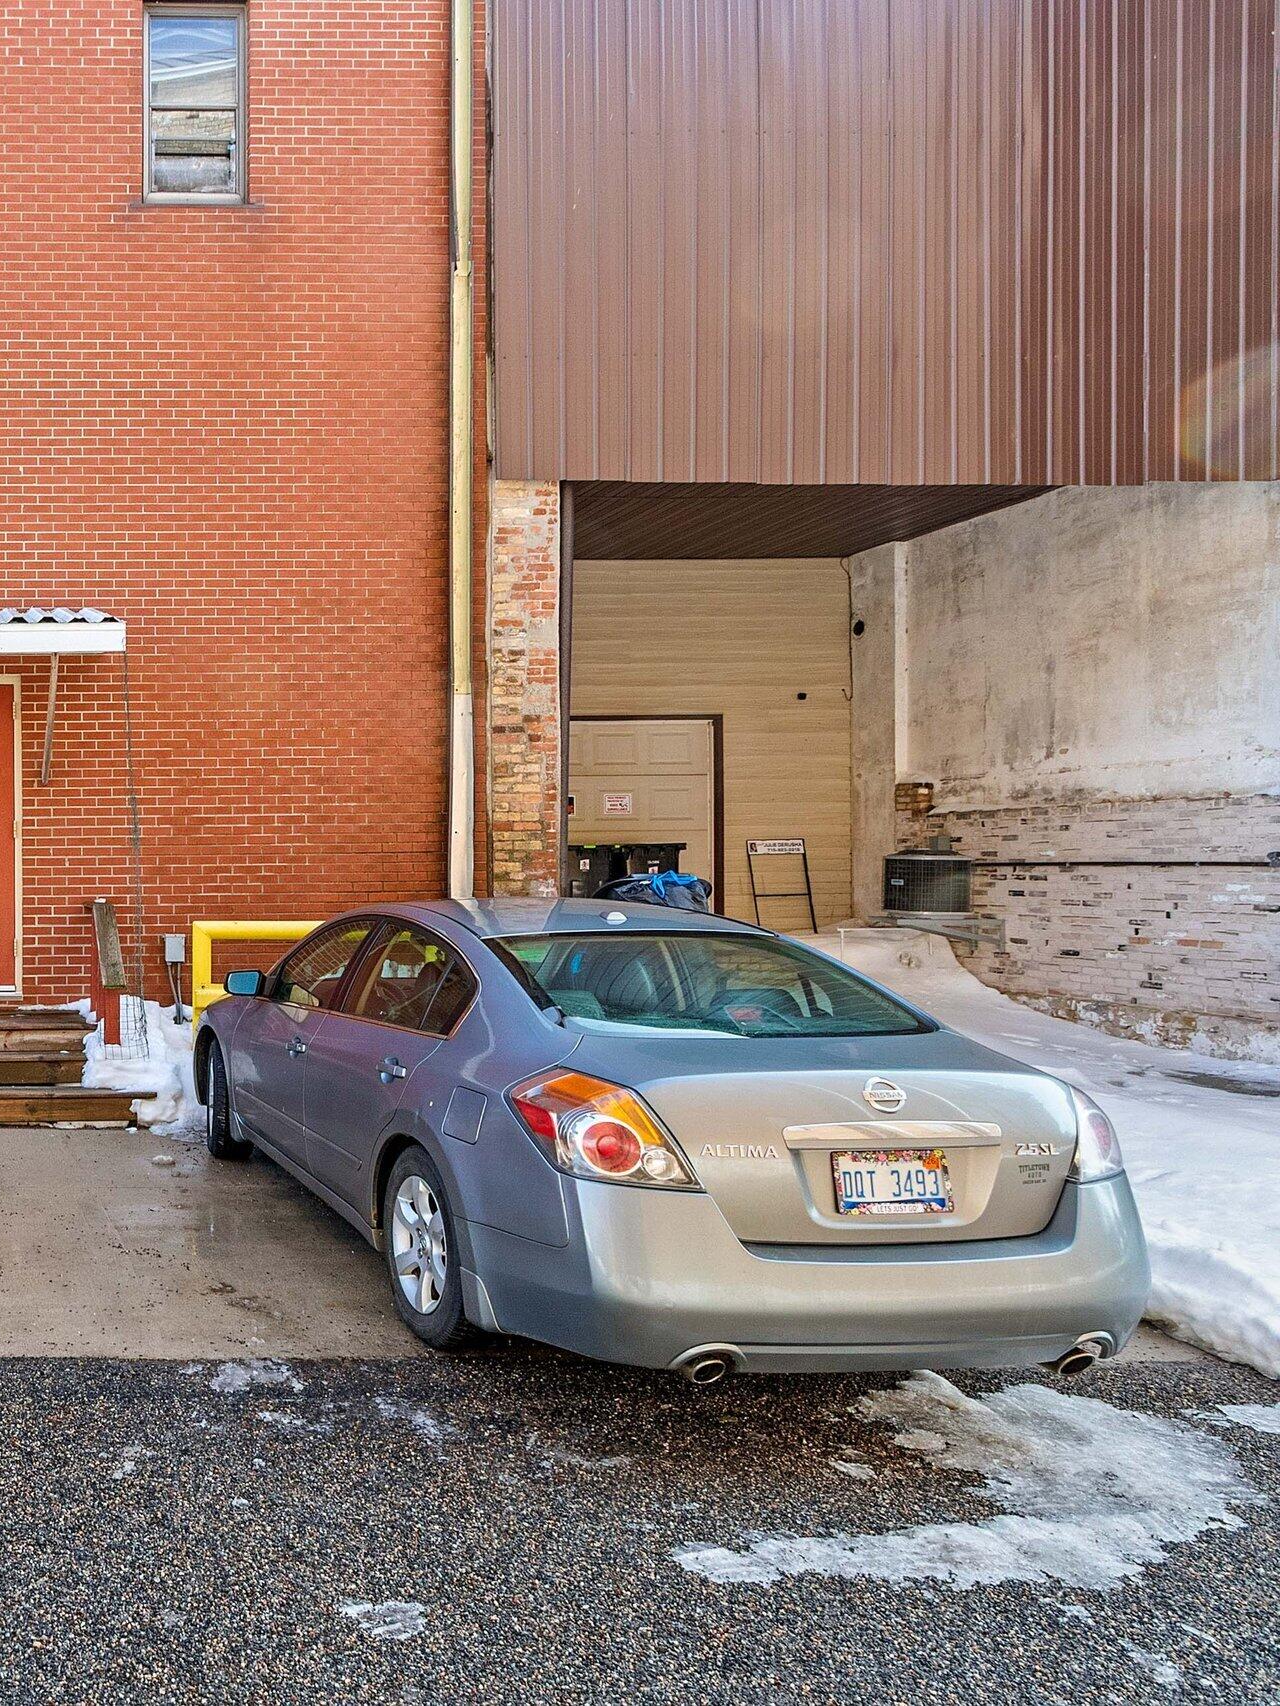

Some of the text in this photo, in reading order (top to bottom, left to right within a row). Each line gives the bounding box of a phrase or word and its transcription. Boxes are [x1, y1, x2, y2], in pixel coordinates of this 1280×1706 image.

[868, 1091, 903, 1099] NISSAN
[700, 1143, 779, 1159] ALTIMA
[842, 1169, 940, 1198] DQT 3493
